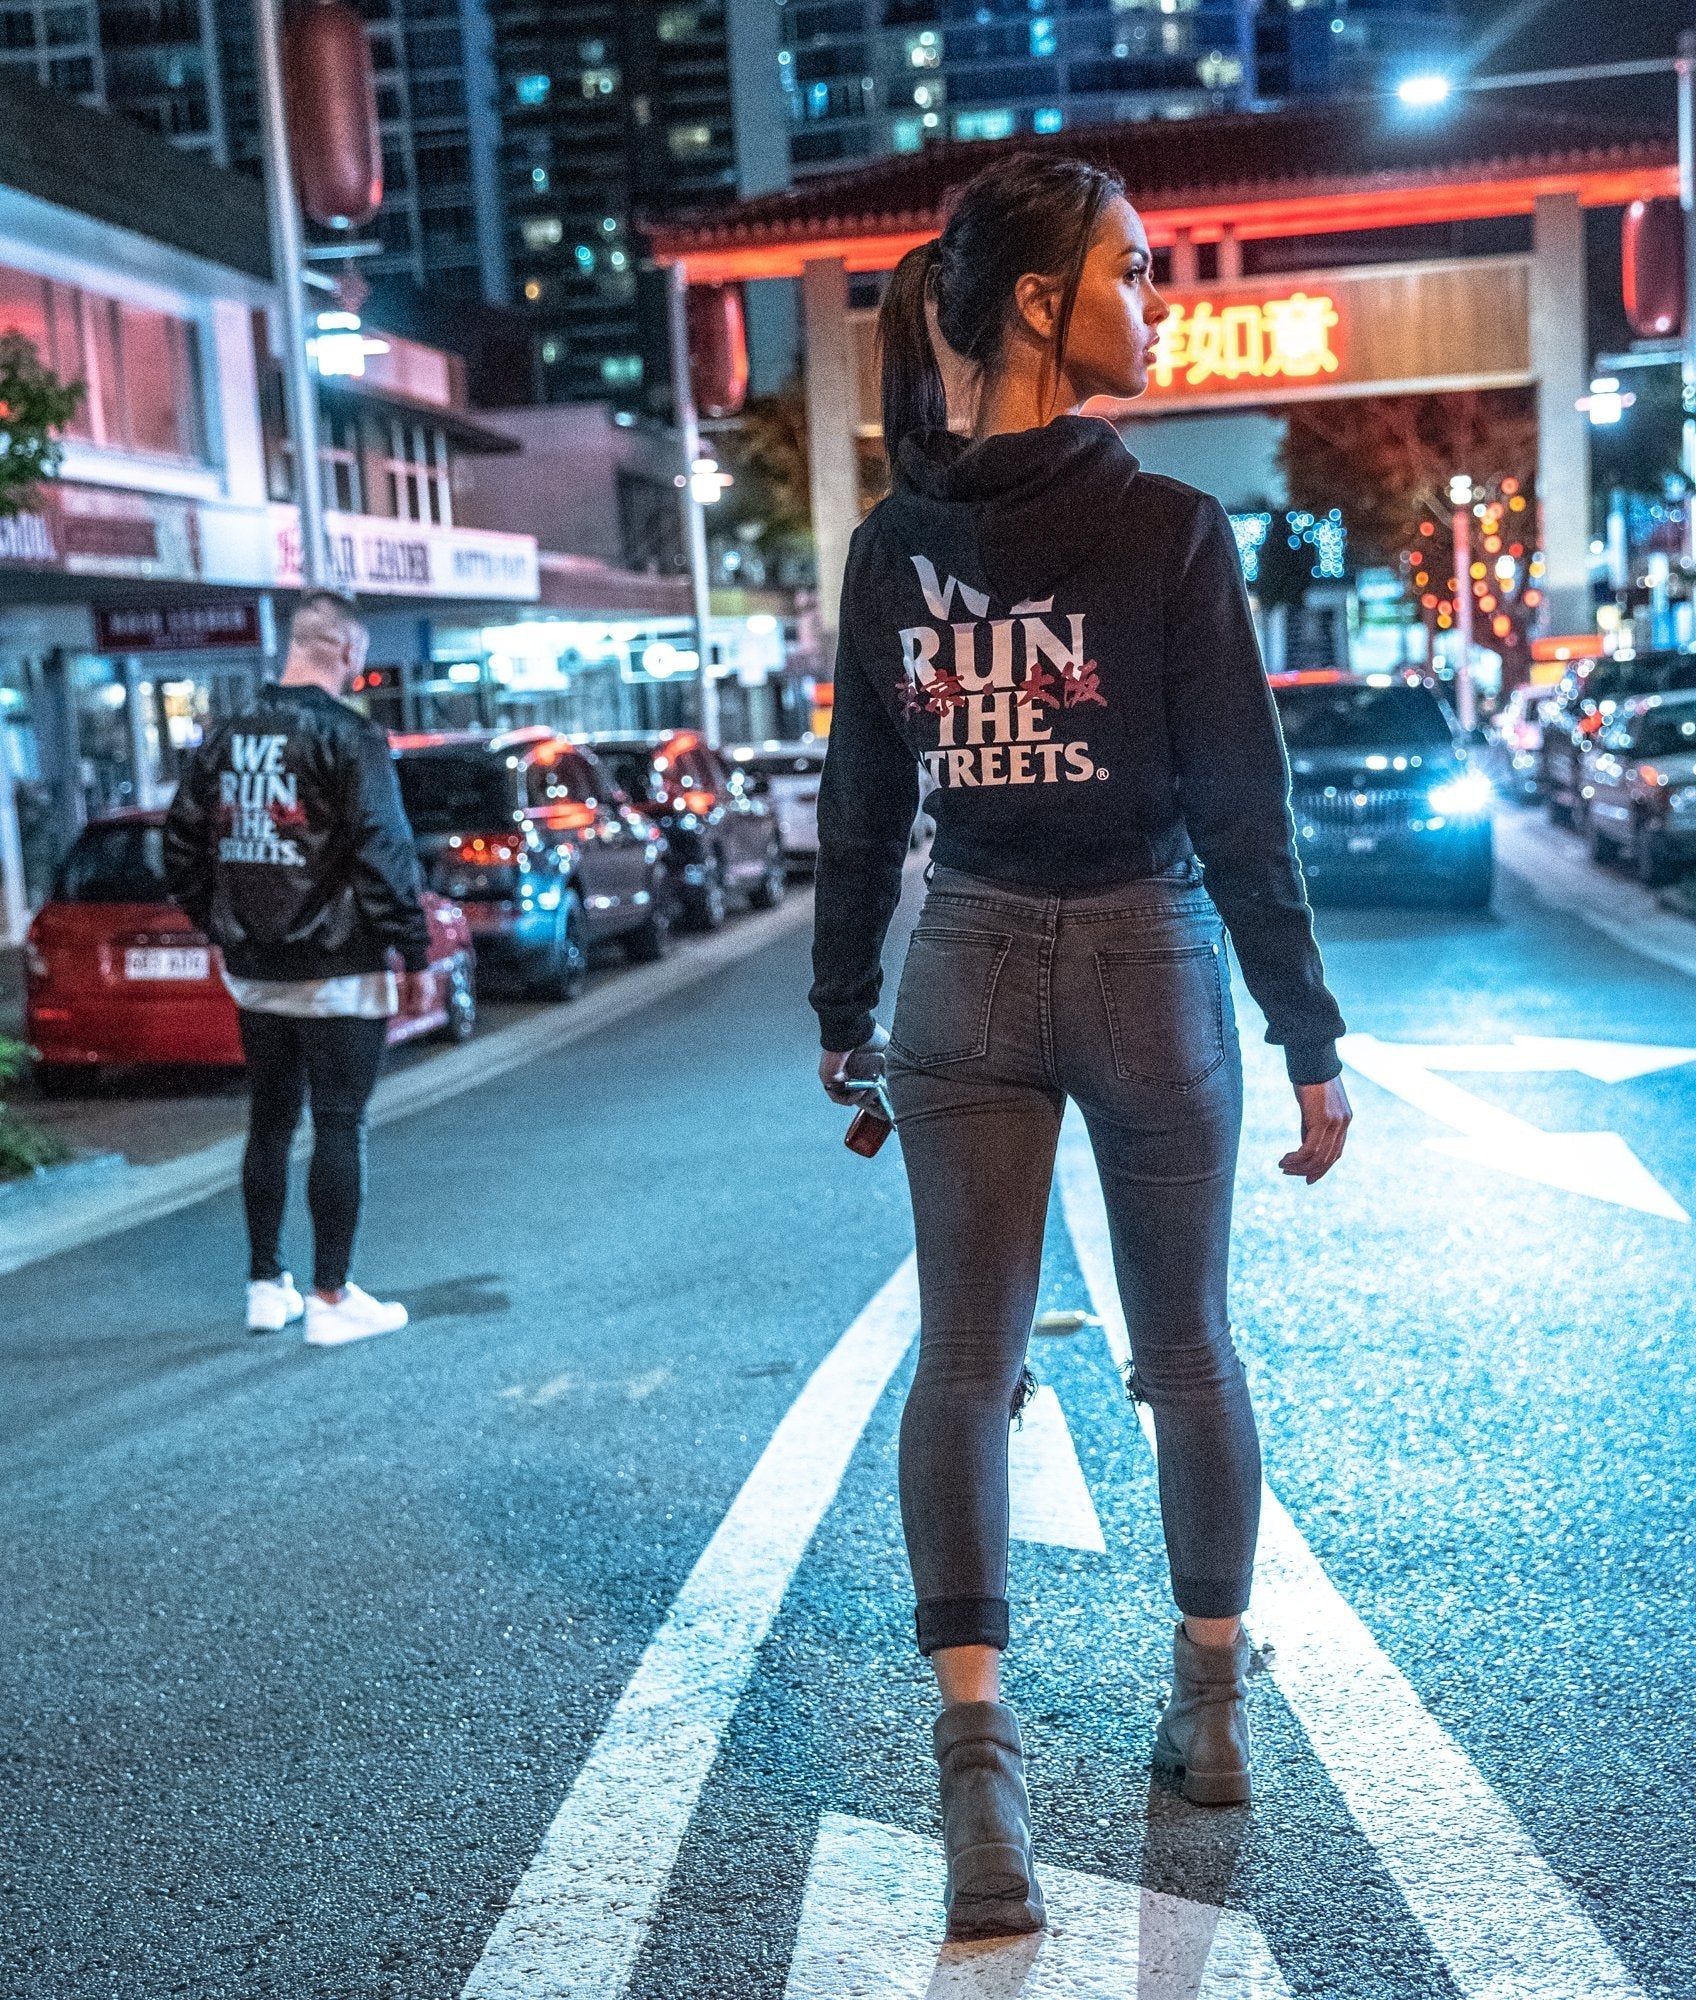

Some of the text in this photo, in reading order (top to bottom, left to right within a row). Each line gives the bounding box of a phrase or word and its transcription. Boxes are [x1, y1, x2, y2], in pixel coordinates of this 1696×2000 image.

[910, 554, 1055, 621] W
[898, 612, 1086, 694] RUN
[930, 690, 1053, 747] THE
[231, 733, 289, 775] WE
[219, 770, 299, 811] RUN
[230, 807, 281, 842] THE
